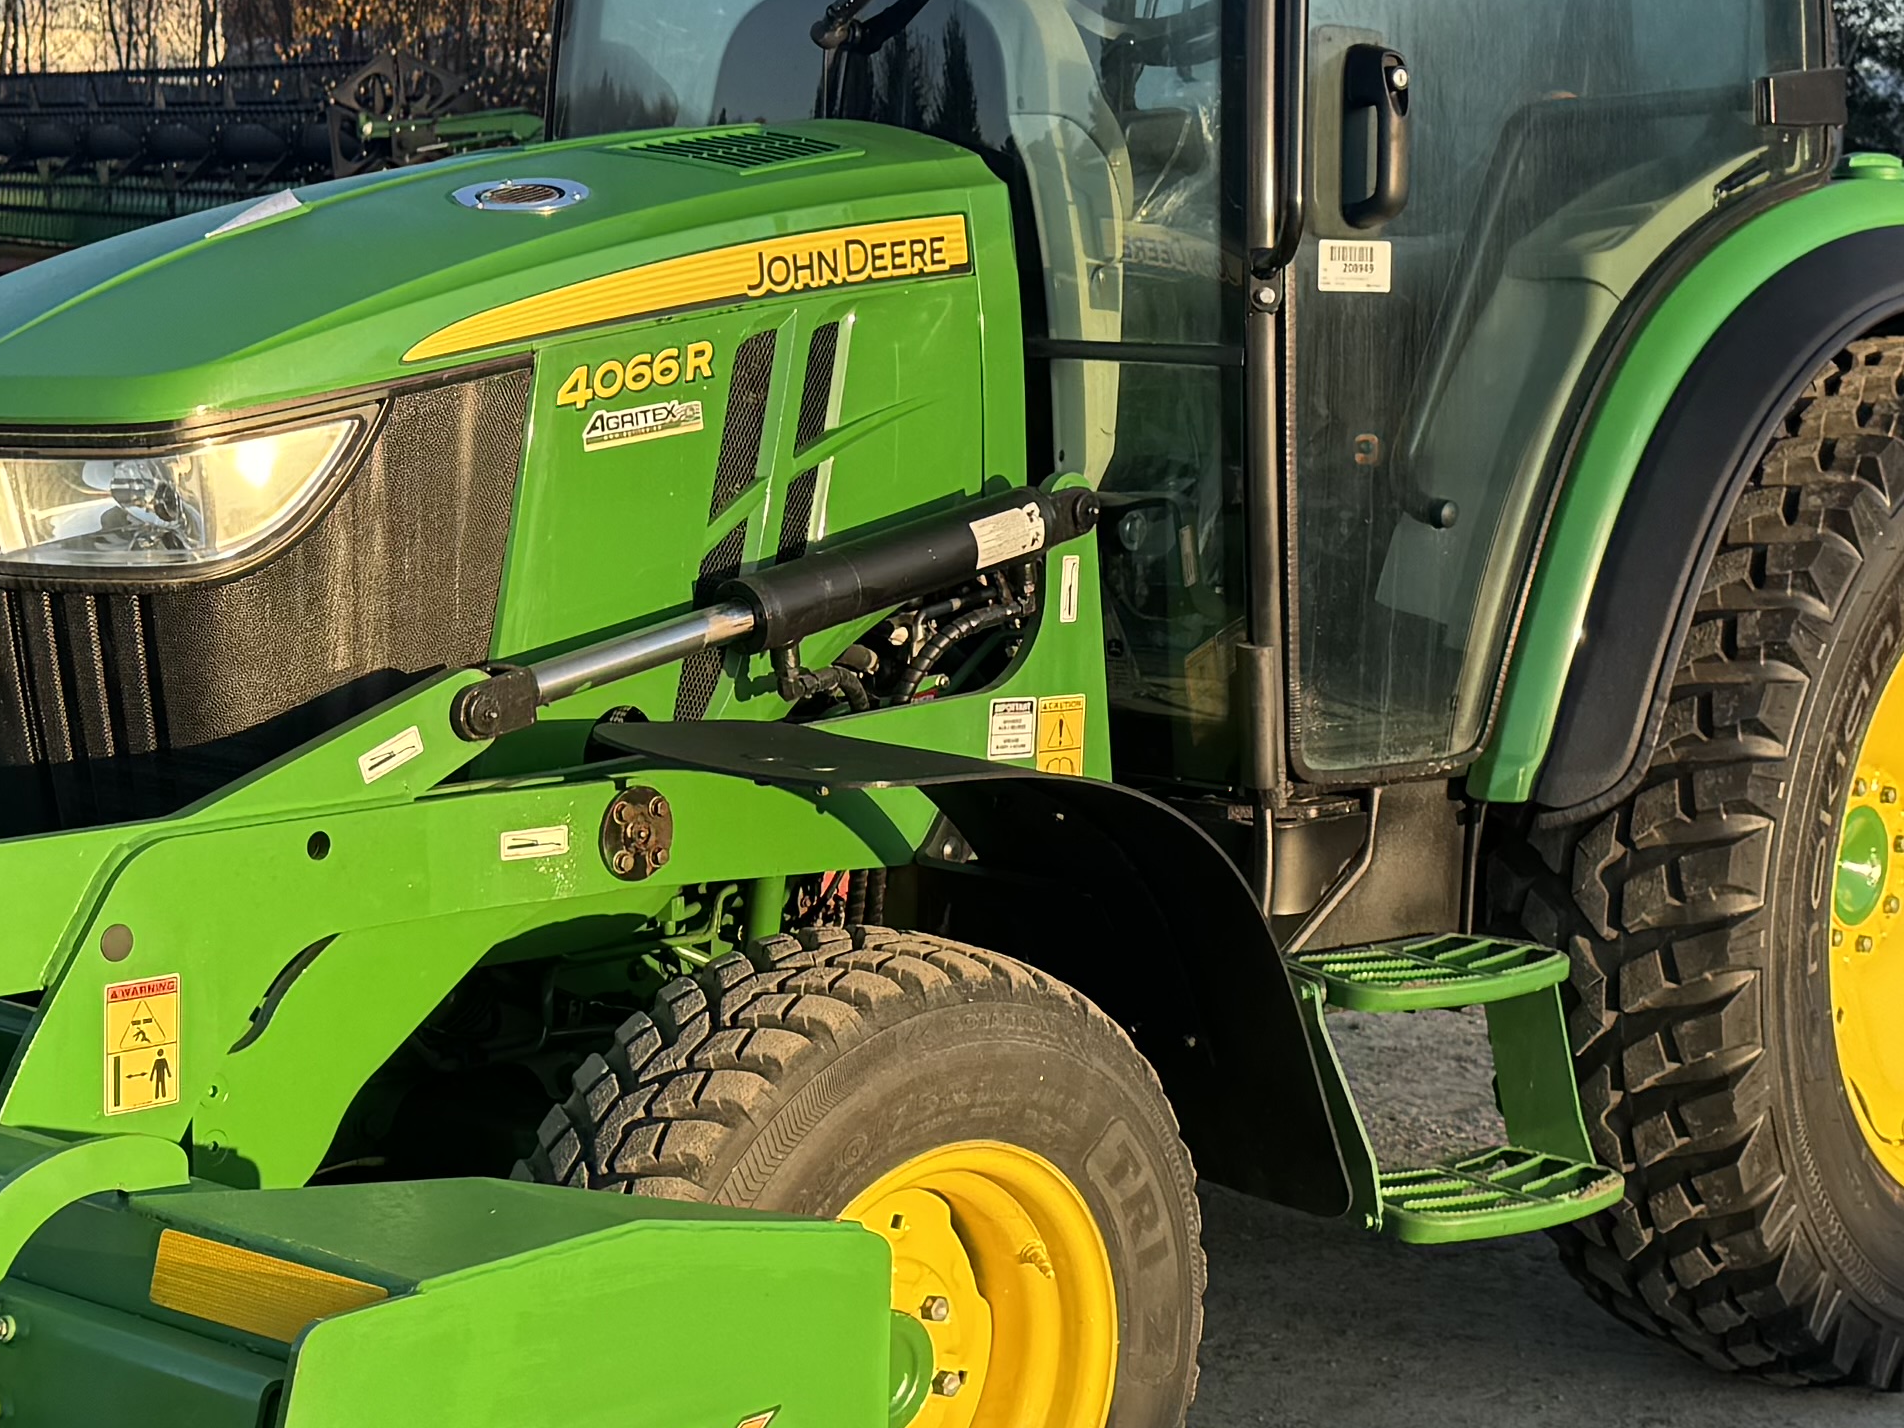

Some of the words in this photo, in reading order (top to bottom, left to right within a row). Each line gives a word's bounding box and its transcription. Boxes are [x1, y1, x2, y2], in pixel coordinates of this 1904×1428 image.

[745, 247, 838, 293] JOHN
[845, 235, 947, 275] DEERE
[555, 340, 715, 411] 4066R
[586, 403, 678, 435] AGRITEX
[121, 980, 175, 998] WARNING
[1101, 1138, 1170, 1272] TRI
